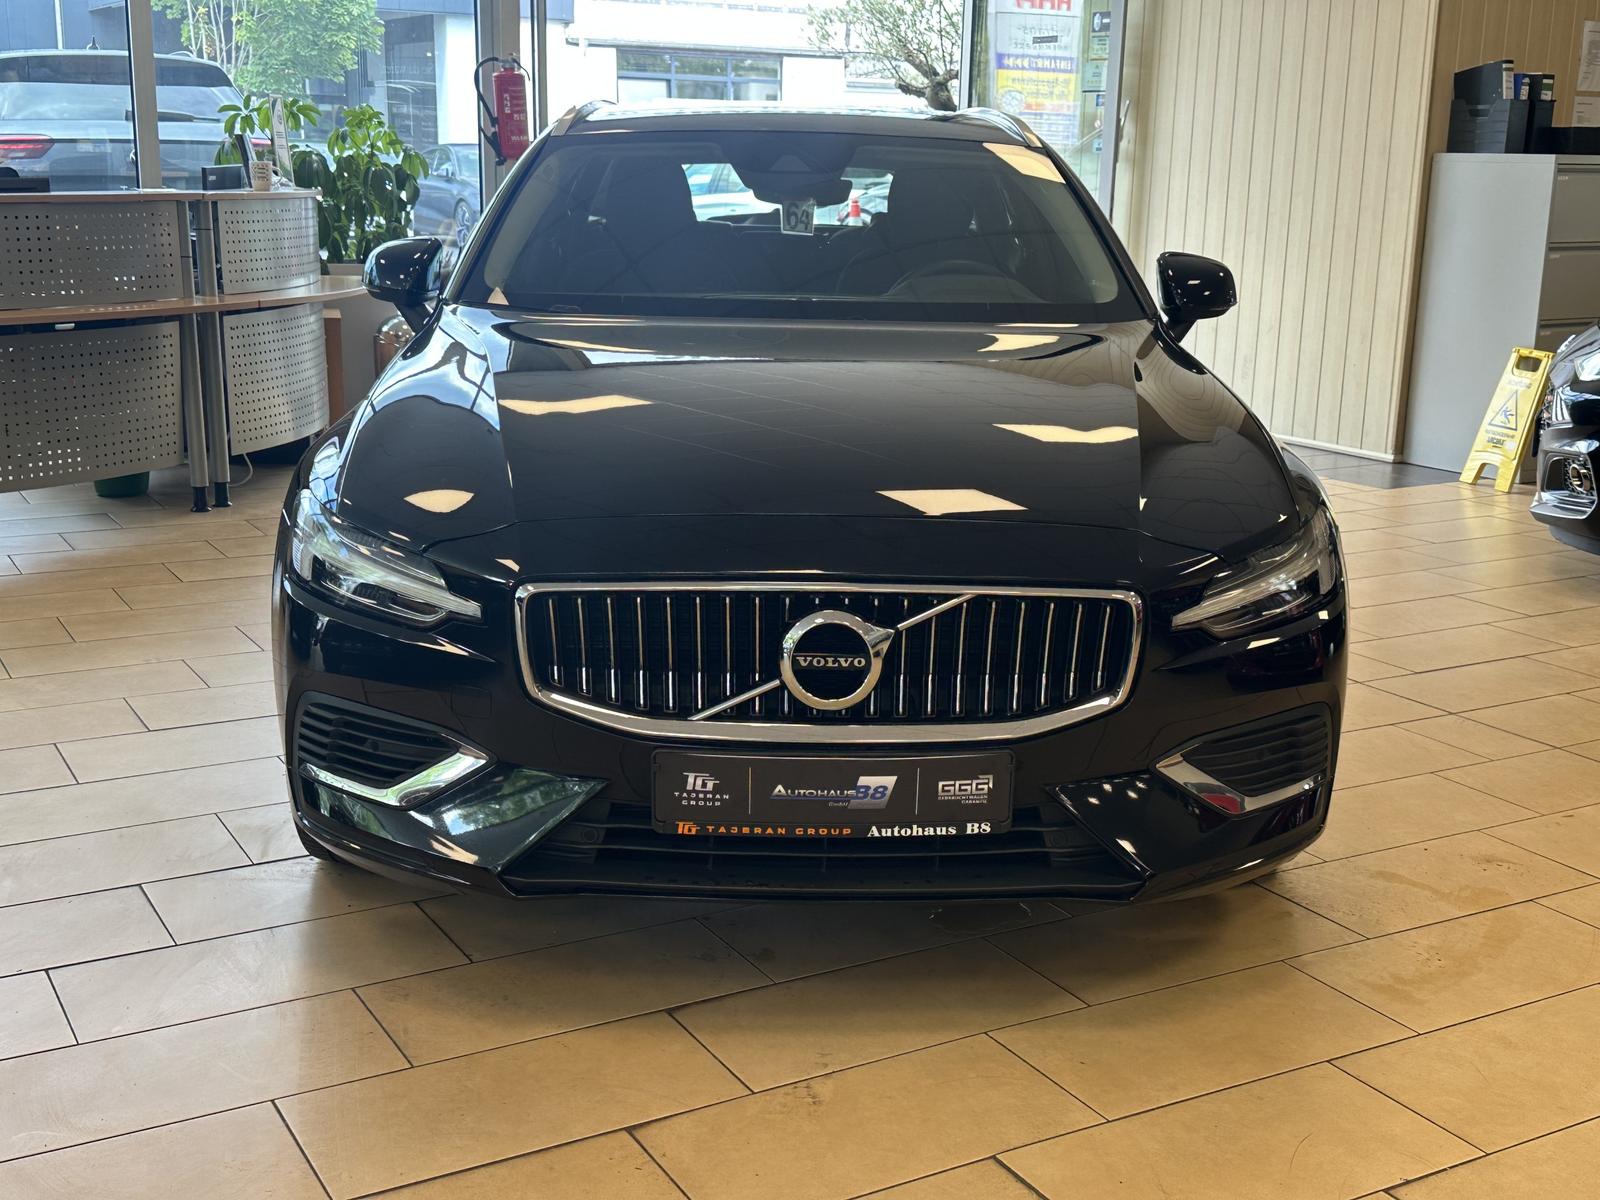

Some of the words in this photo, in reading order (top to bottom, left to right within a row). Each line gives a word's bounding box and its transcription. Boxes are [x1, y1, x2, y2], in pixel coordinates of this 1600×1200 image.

[786, 202, 810, 231] 64
[796, 657, 866, 667] VOLVO
[856, 785, 889, 800] B8
[938, 779, 989, 795] GGG
[706, 825, 787, 835] TAJERAN
[795, 827, 852, 836] GROUP
[867, 824, 957, 838] Autohaus
[965, 822, 992, 835] B8
